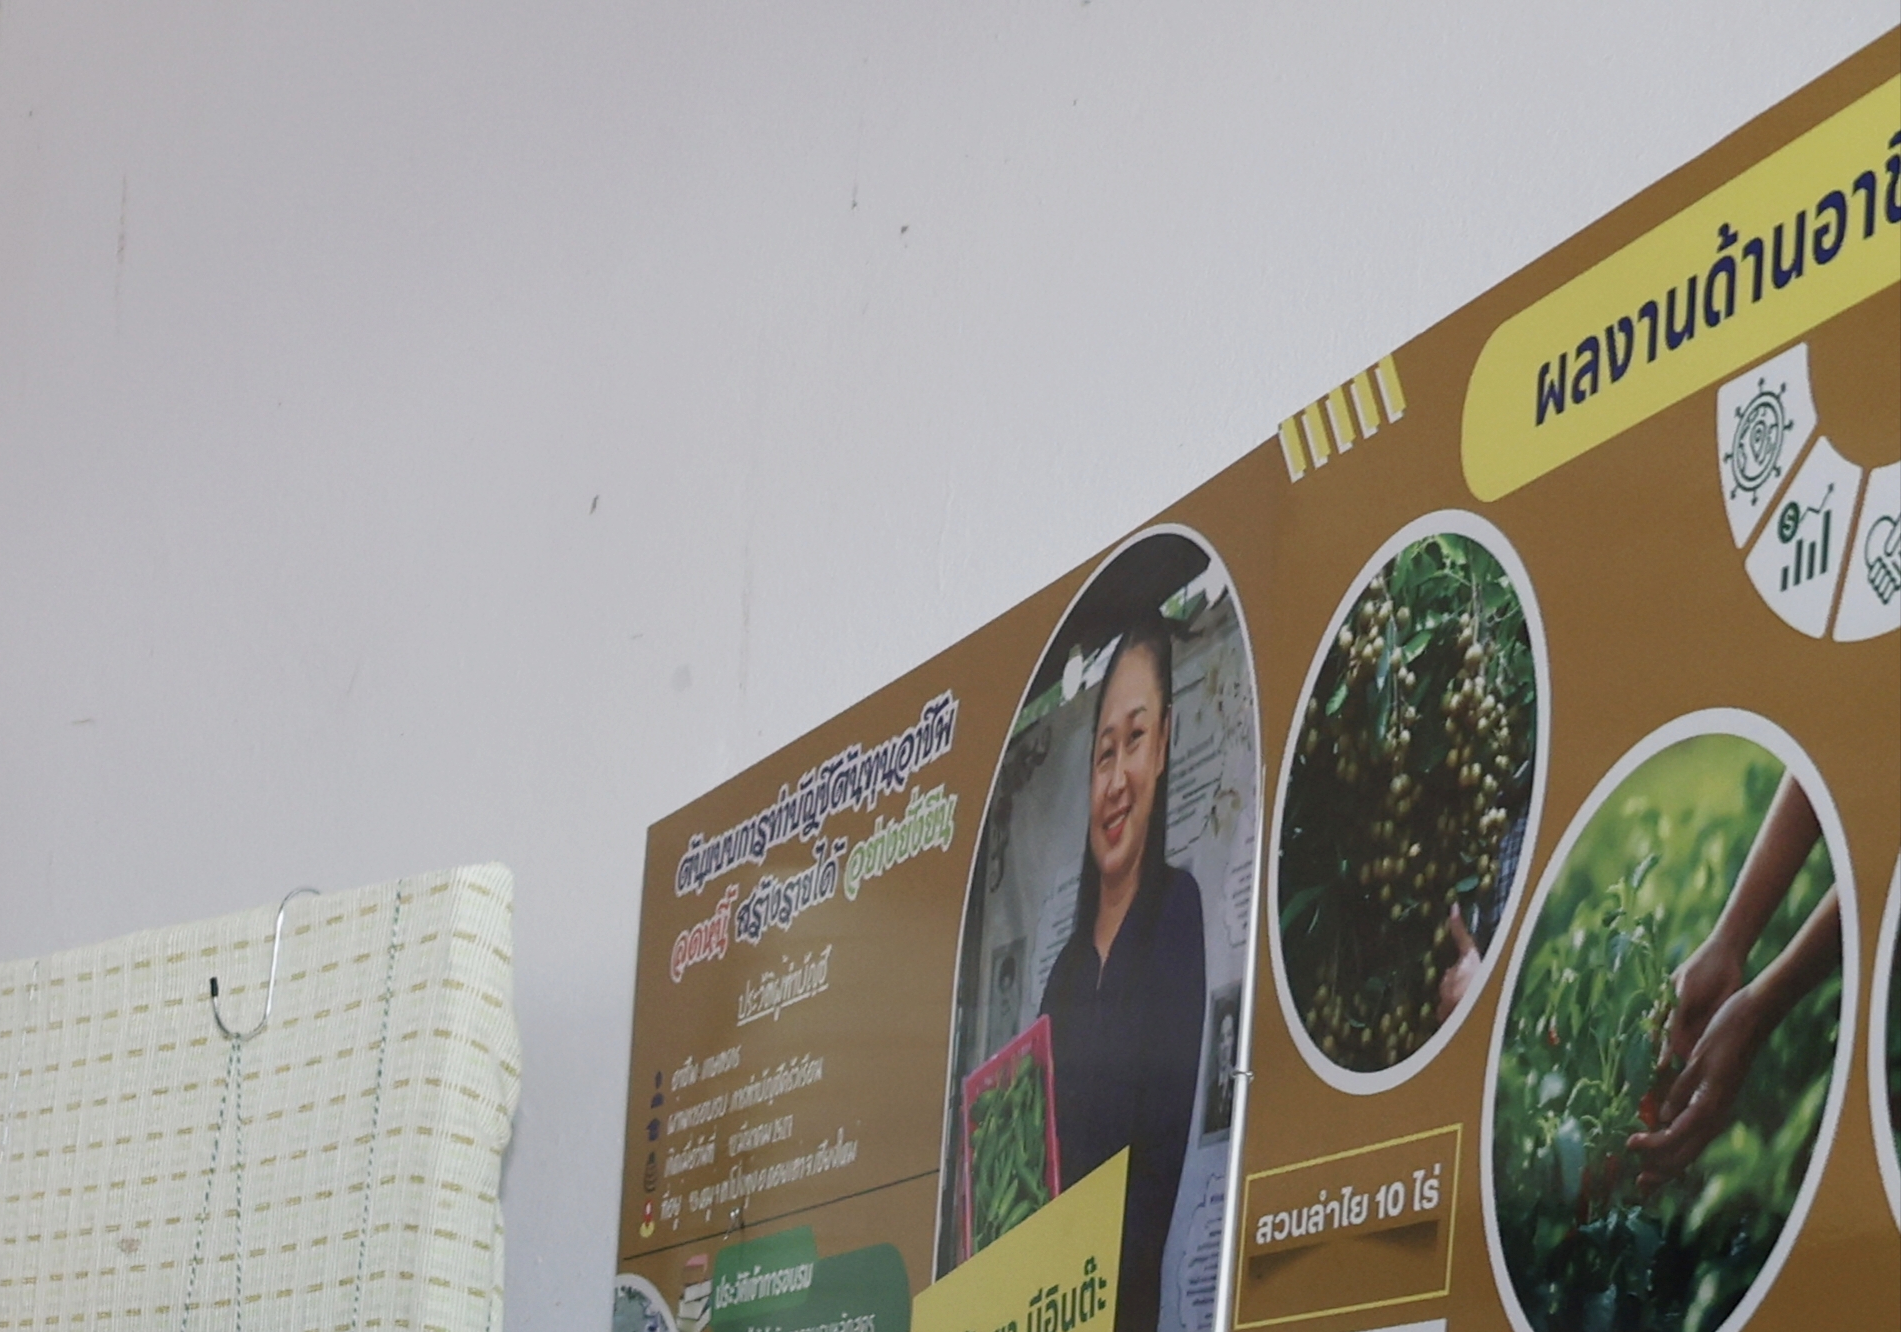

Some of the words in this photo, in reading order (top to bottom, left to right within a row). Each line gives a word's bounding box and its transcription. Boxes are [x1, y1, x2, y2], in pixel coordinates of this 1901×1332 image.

[1255, 1190, 1370, 1245] สวนลำไย
[1374, 1180, 1406, 1220] 10
[1411, 1161, 1441, 1212] ไร่
